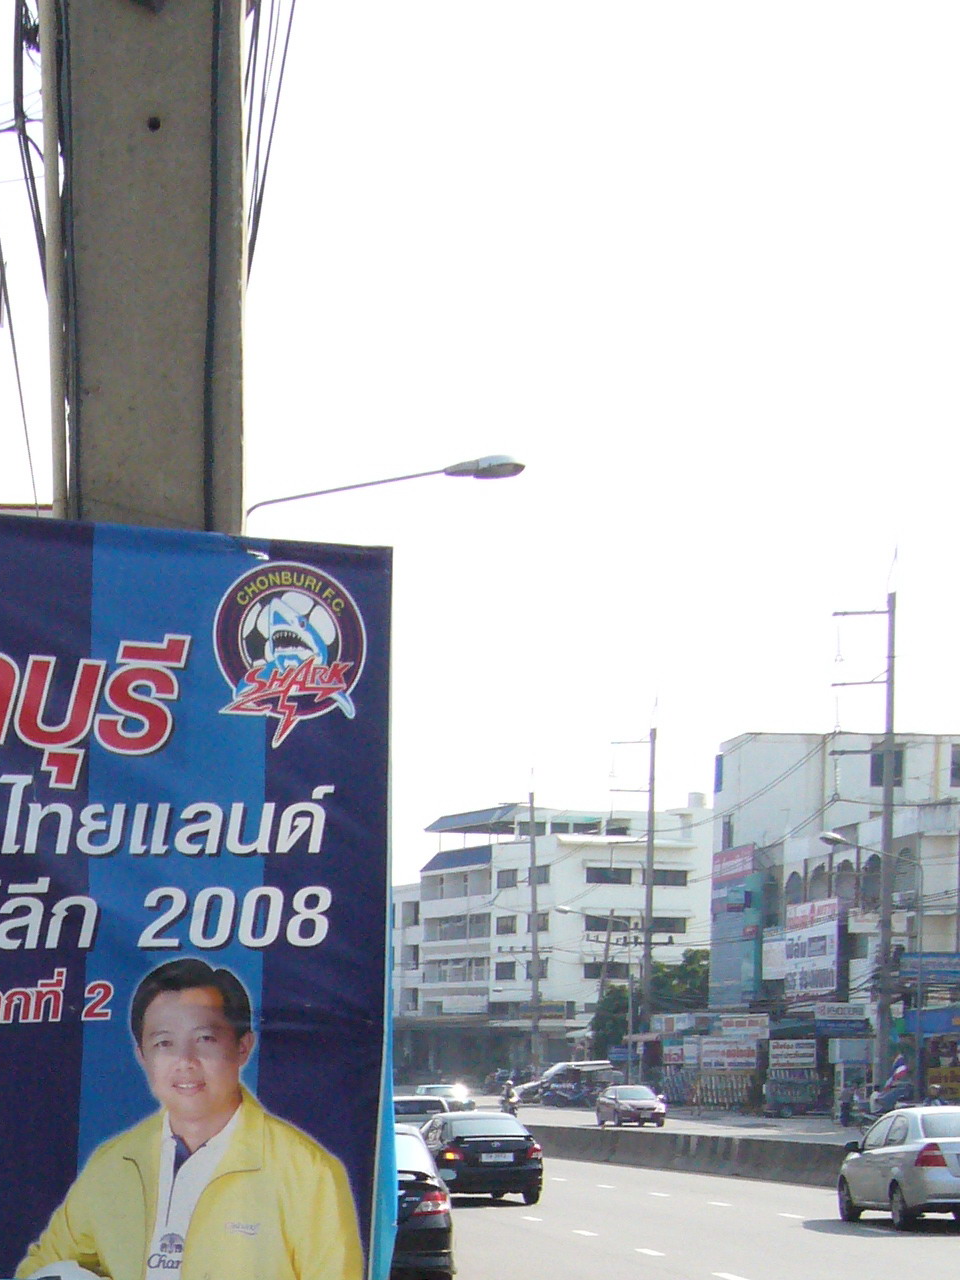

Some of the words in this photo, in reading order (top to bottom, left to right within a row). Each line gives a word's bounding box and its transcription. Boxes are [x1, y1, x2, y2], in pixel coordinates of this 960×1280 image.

[236, 571, 323, 606] CHONBURI
[235, 656, 354, 704] SHARK
[137, 886, 332, 950] 2008
[82, 981, 113, 1022] 2
